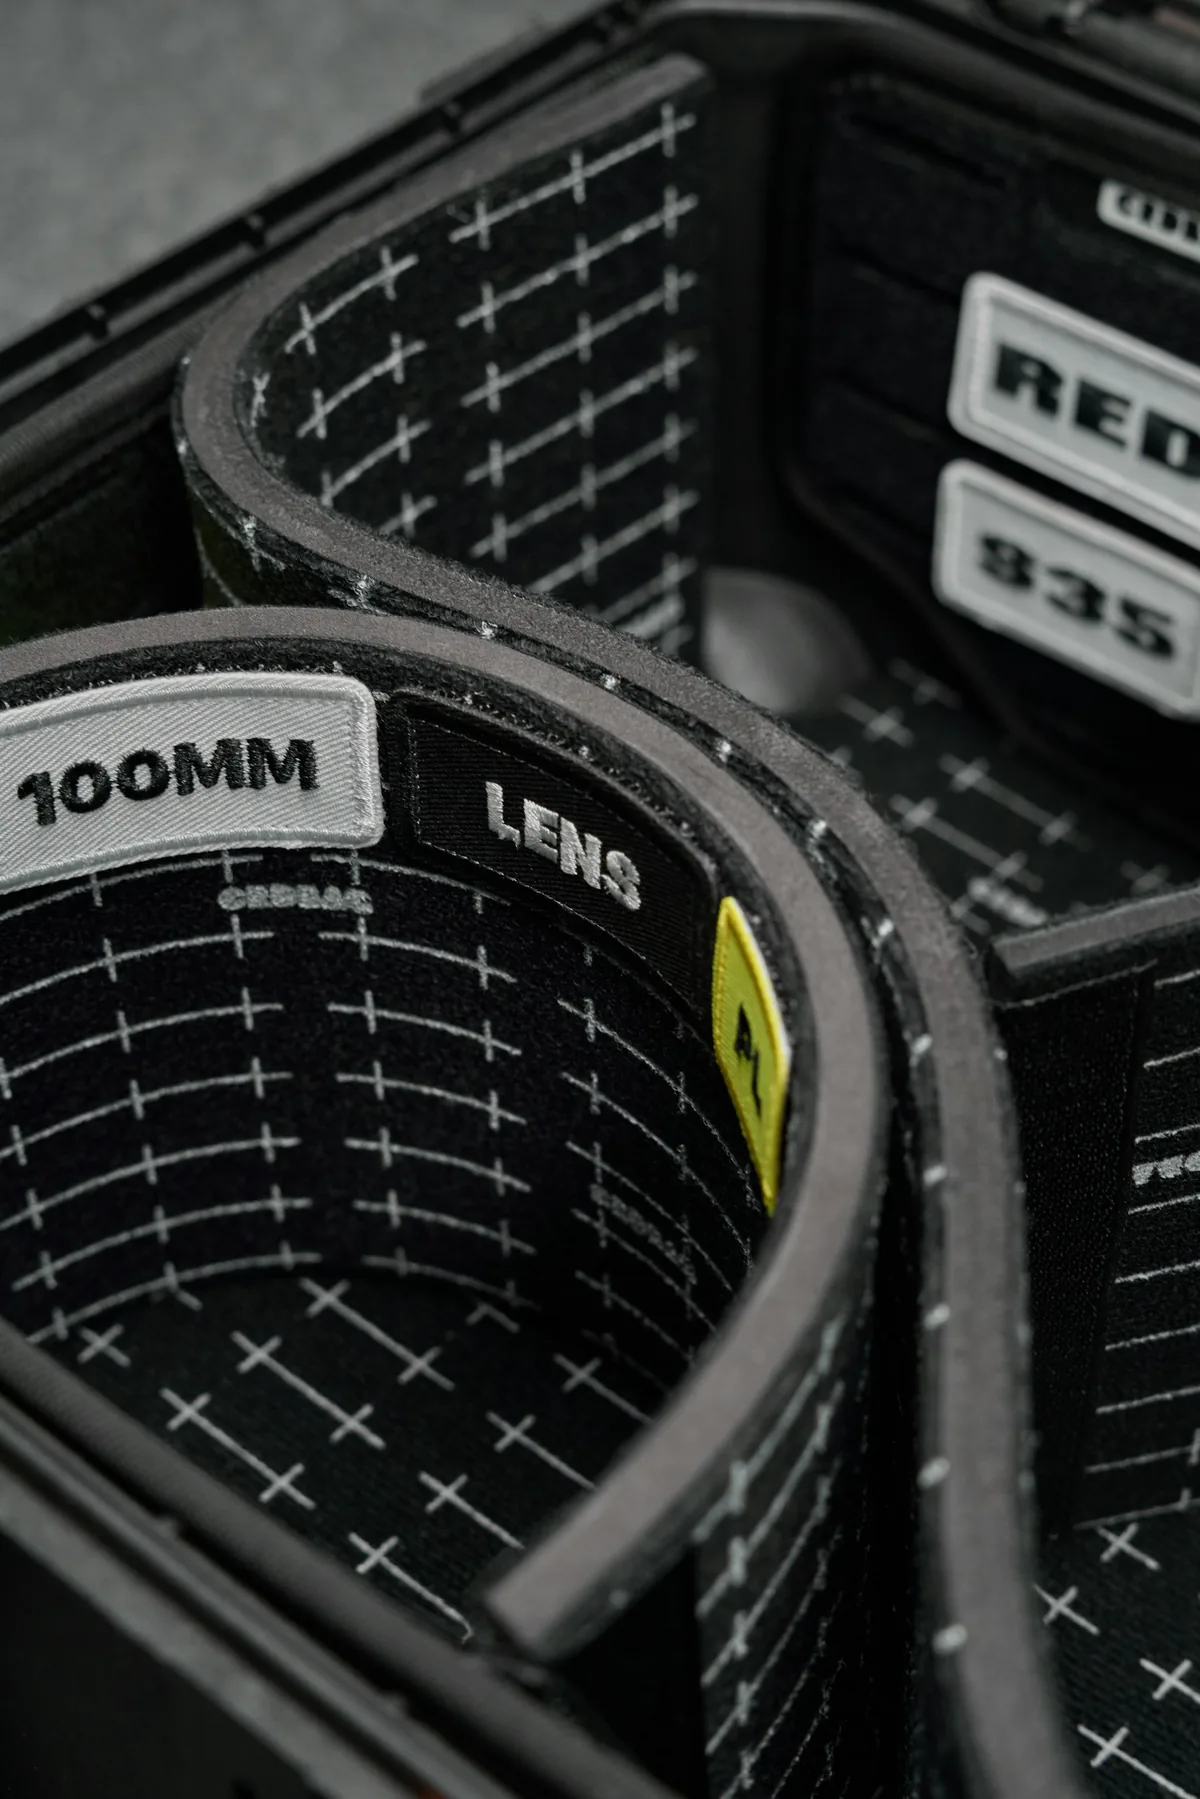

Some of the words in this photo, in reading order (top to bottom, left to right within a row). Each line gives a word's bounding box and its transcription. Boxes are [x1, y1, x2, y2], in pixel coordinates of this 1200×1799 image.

[995, 343, 1200, 479] RED
[18, 737, 319, 827] 100MM
[486, 782, 641, 910] LENS
